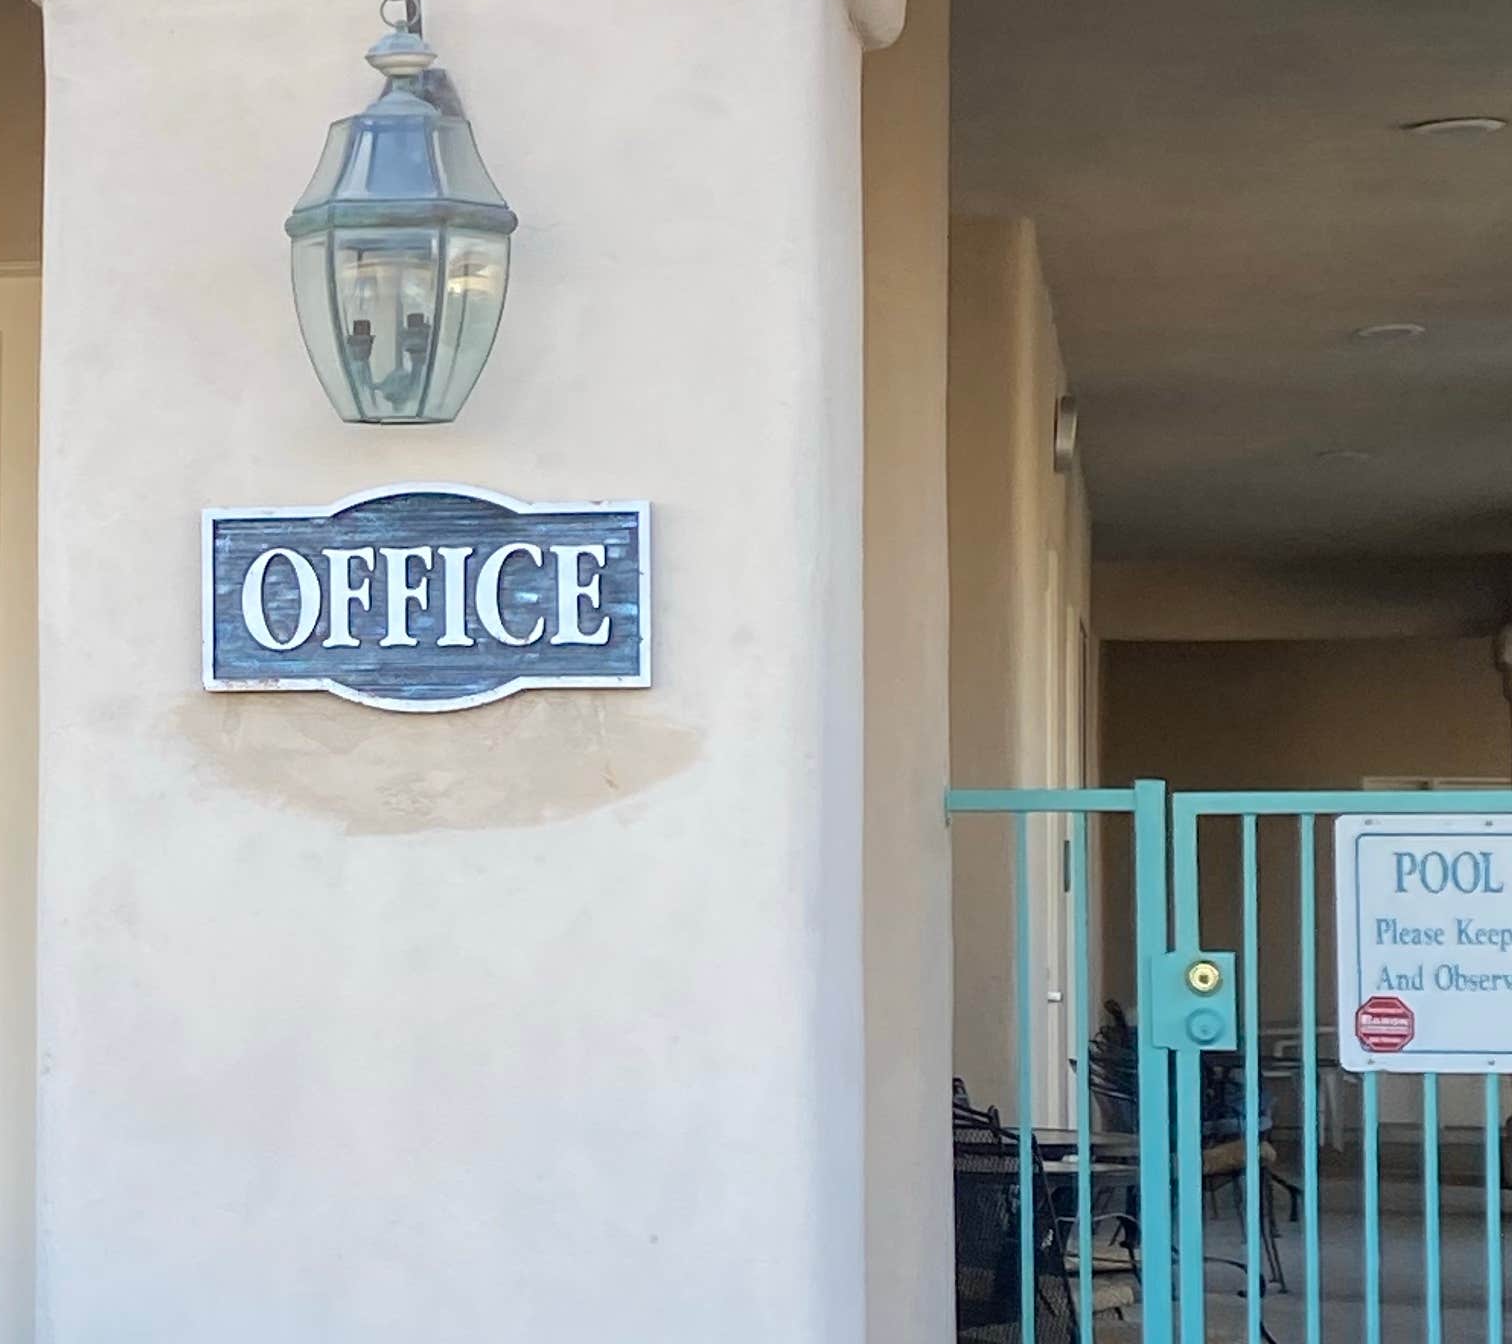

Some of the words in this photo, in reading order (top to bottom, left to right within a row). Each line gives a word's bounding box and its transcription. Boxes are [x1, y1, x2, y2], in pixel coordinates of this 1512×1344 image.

[242, 542, 611, 651] OFFICE
[1394, 850, 1505, 894] POOL
[1376, 918, 1445, 946] Please
[1377, 964, 1425, 992] And
